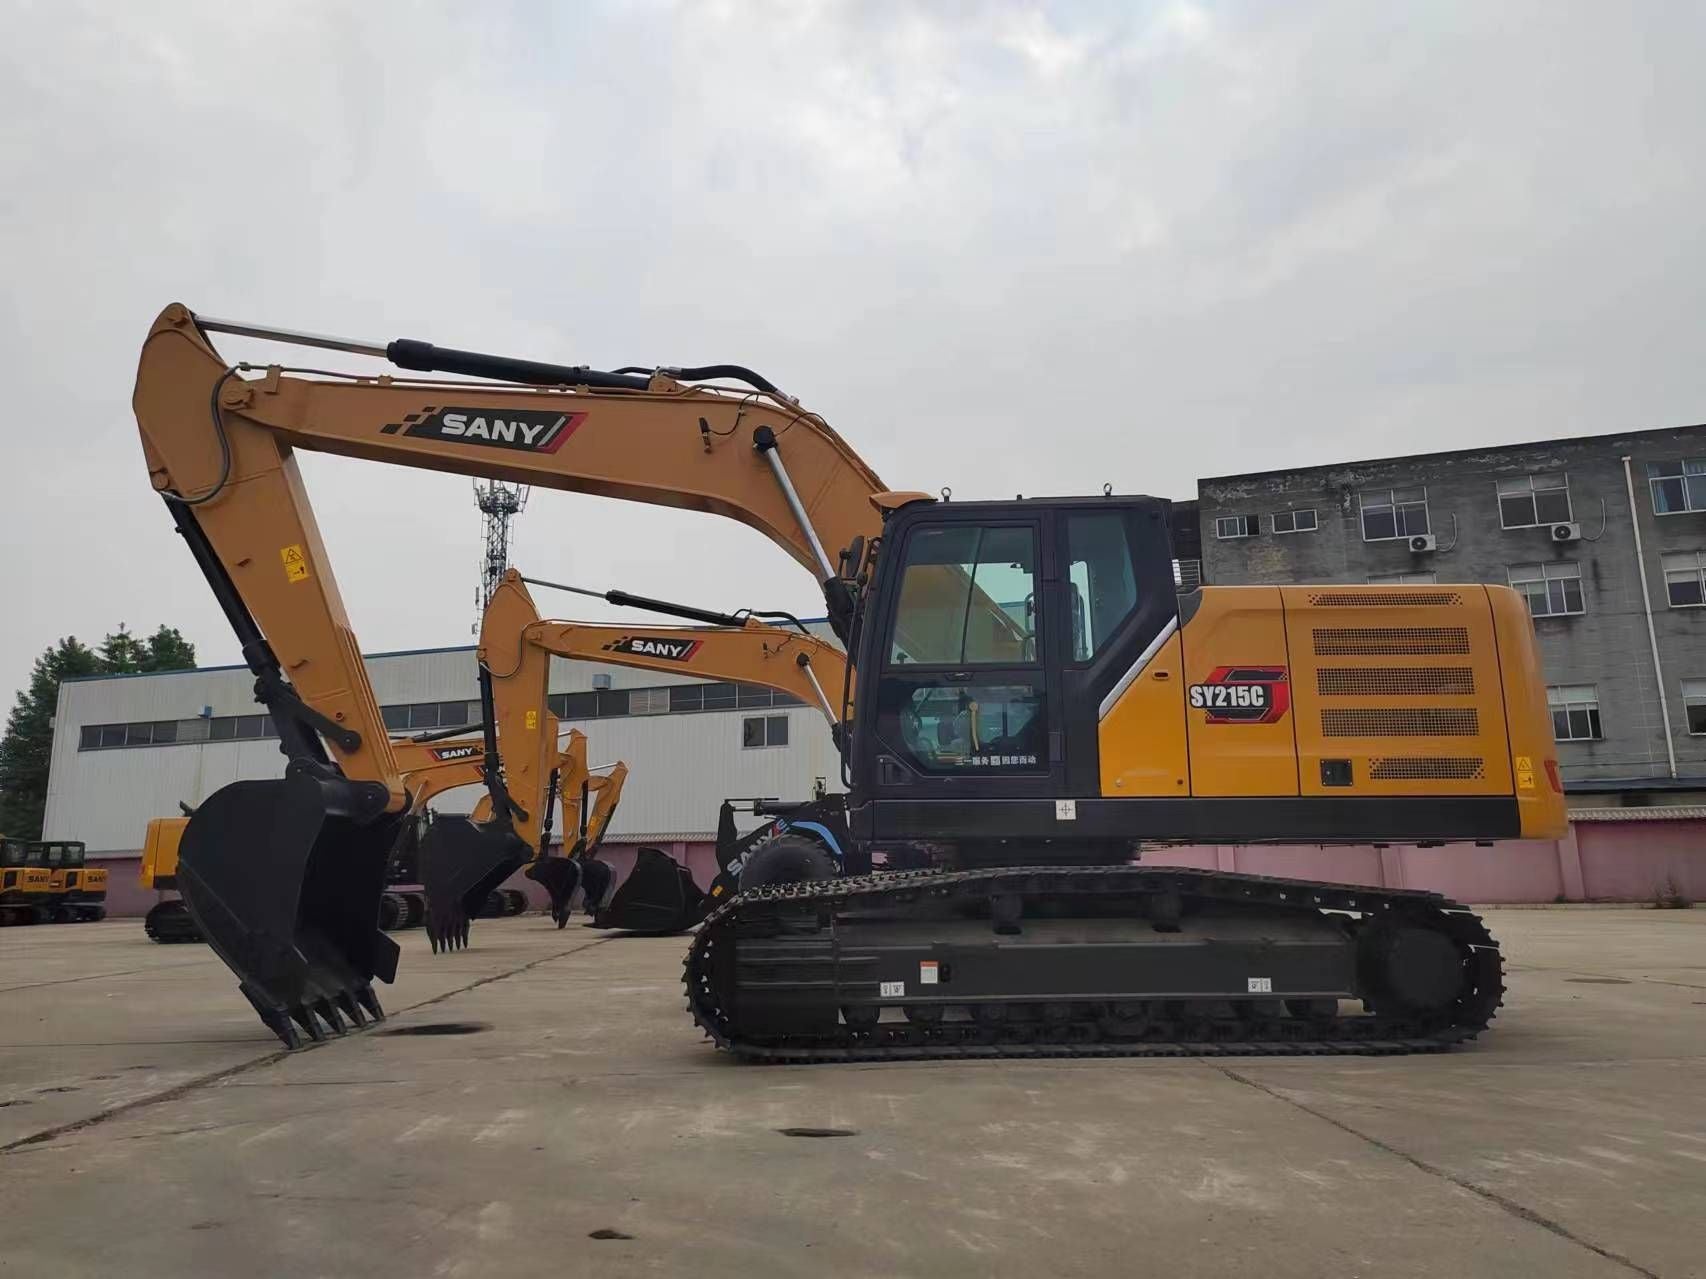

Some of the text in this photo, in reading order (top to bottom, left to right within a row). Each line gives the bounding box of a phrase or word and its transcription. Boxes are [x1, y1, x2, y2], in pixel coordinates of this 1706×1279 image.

[441, 413, 544, 444] SANY
[631, 640, 682, 657] SANY
[1190, 685, 1264, 707] SY215C
[441, 747, 473, 759] SANY
